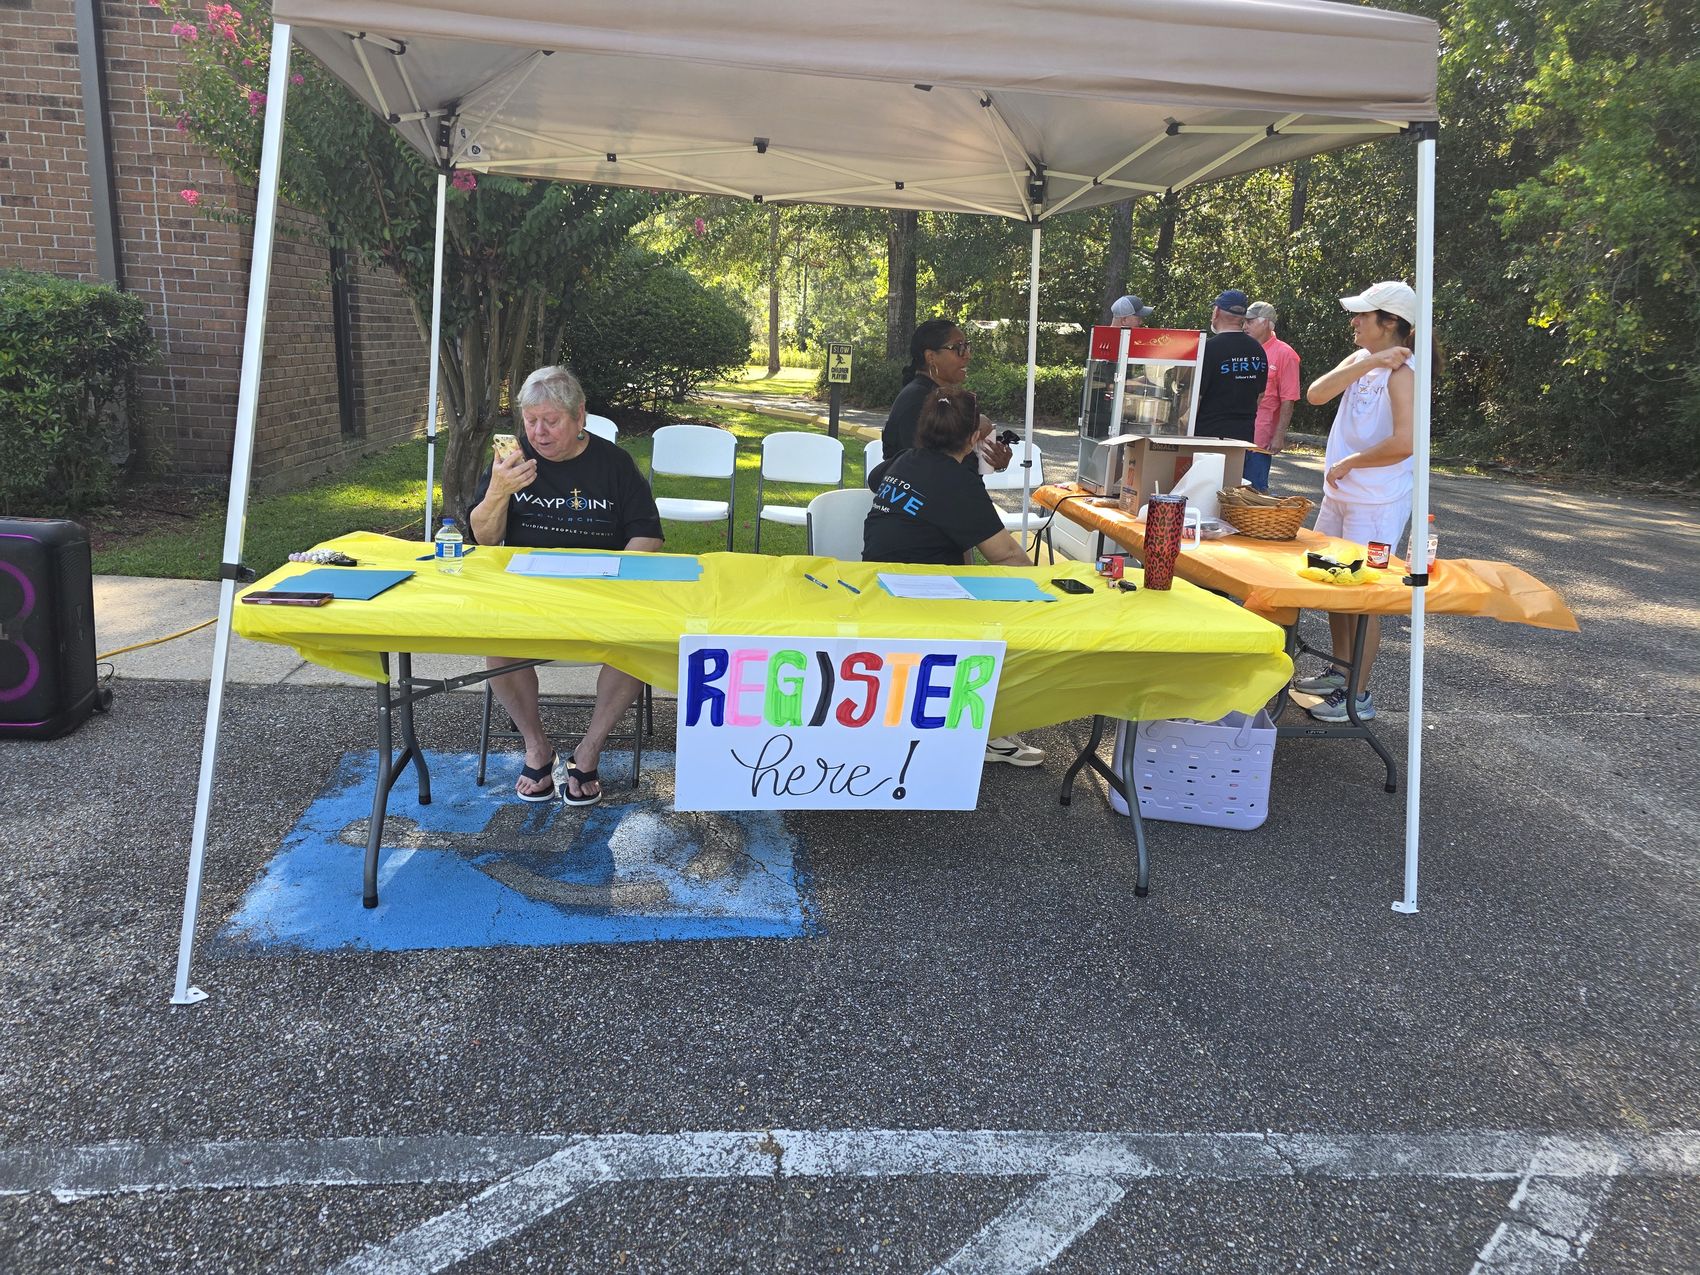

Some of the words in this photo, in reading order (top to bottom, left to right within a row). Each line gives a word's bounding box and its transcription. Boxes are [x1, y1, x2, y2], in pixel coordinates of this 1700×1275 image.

[832, 345, 850, 353] SLOW
[1220, 361, 1266, 374] SERVE
[1152, 443, 1176, 451] SMALL
[898, 480, 911, 490] TO
[514, 491, 614, 511] WAYPOINT
[877, 483, 924, 516] RVE
[537, 513, 593, 522] CHURCH
[521, 522, 549, 530] GUIDING
[685, 648, 996, 729] REGISTER
[730, 733, 921, 801] here!
